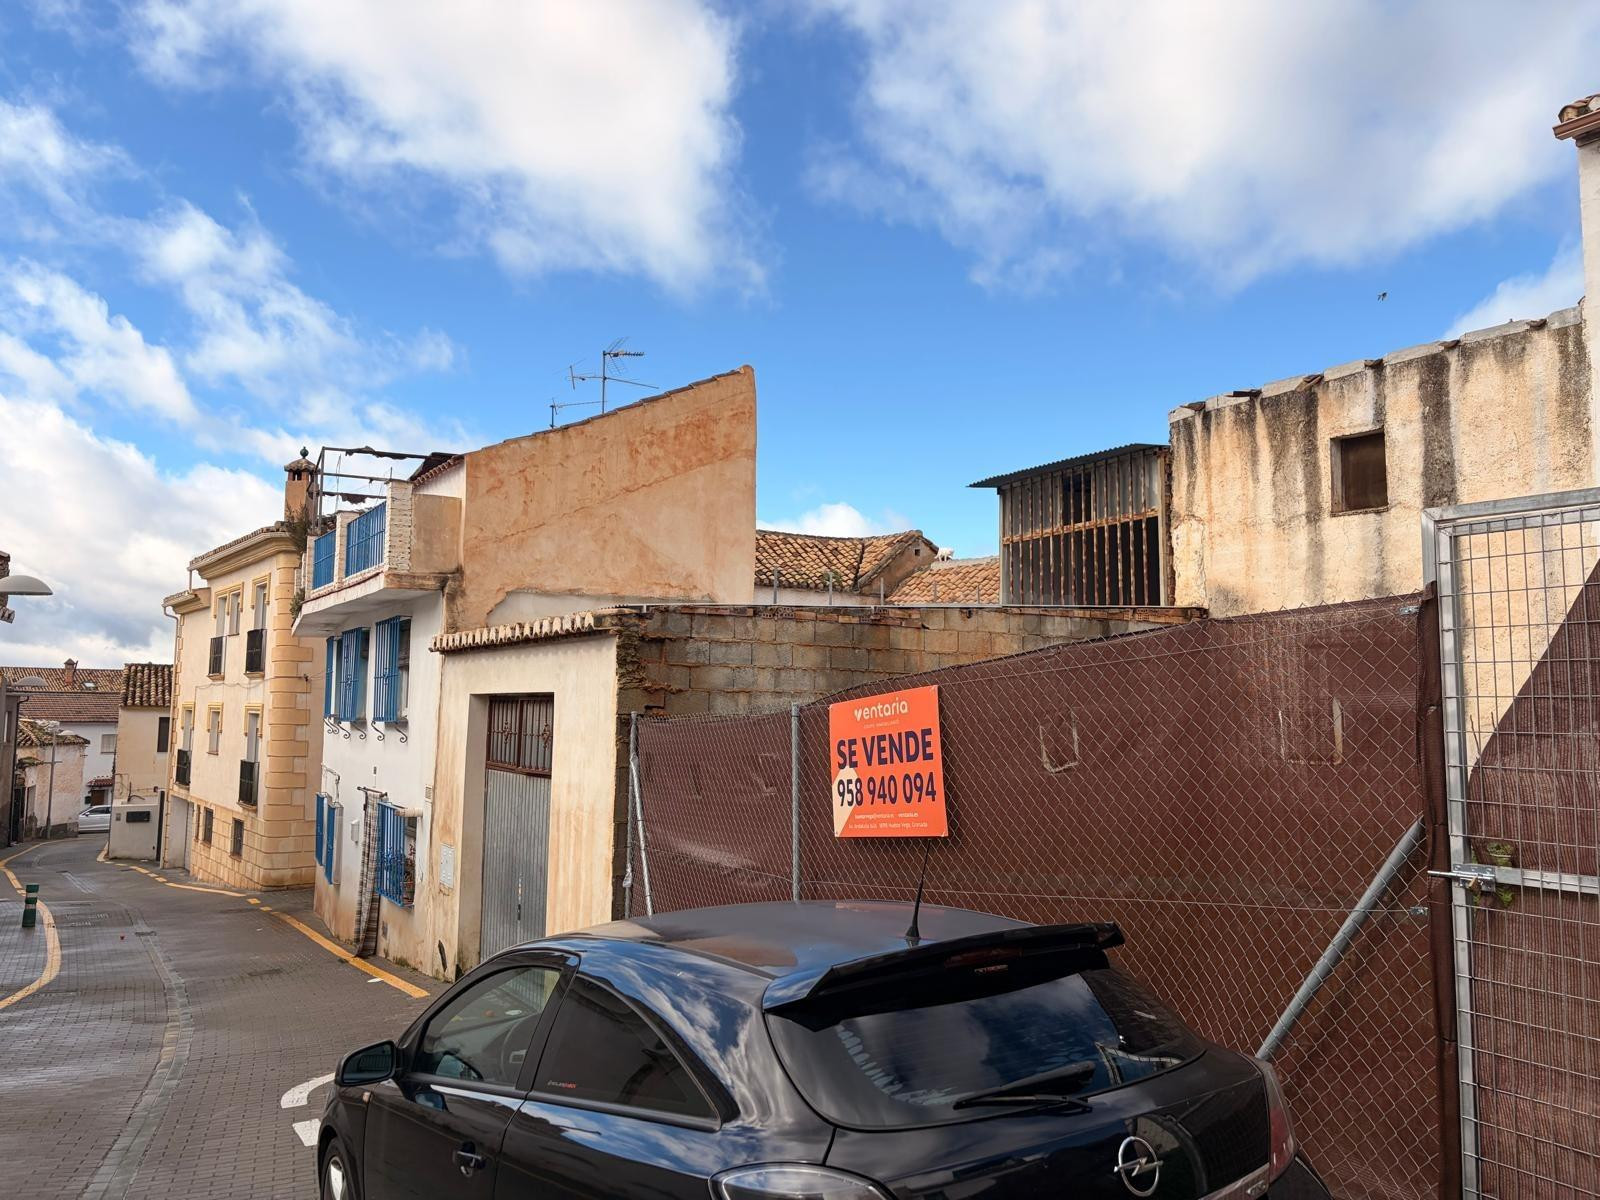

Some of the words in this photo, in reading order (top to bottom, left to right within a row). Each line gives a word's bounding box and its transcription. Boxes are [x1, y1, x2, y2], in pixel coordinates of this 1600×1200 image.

[854, 697, 908, 721] ventaria
[837, 738, 858, 770] SE
[862, 728, 934, 766] VENDE
[837, 777, 864, 807] 958
[867, 775, 898, 806] 940
[902, 771, 937, 804] 094
